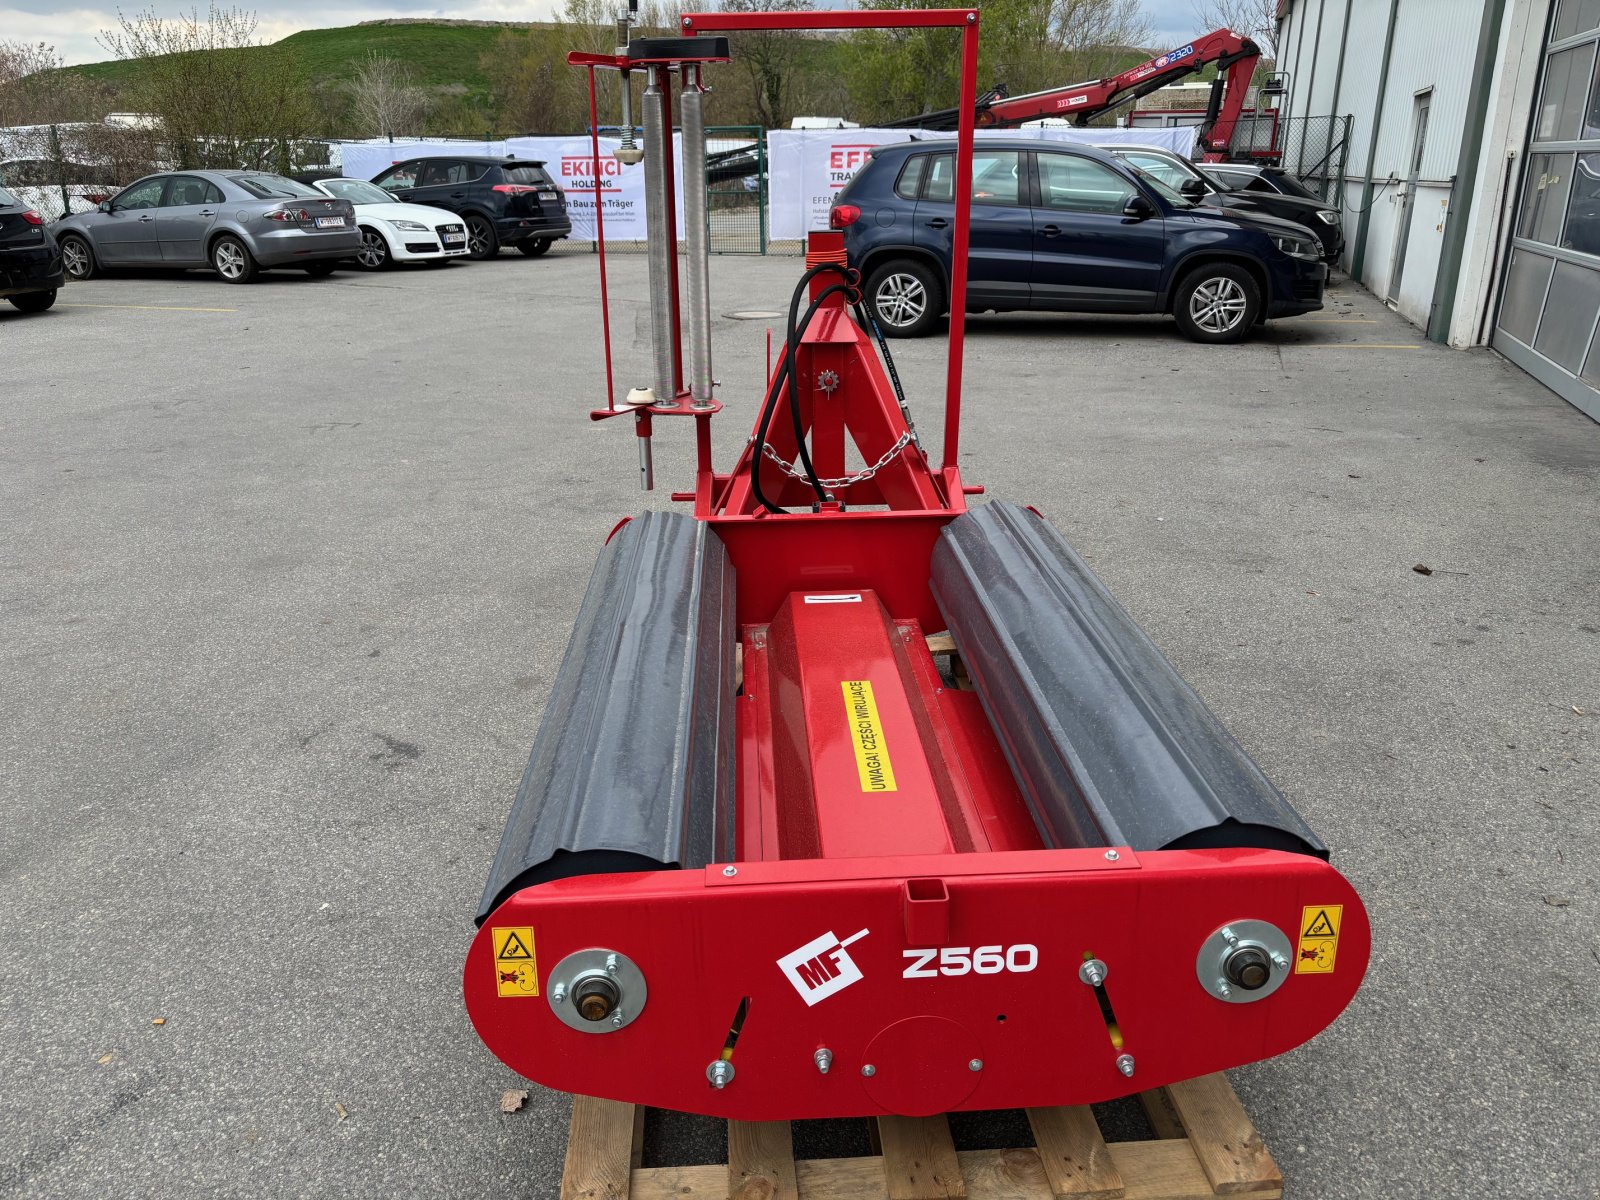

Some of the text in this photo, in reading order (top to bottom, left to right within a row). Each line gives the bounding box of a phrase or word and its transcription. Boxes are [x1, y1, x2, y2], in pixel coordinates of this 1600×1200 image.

[1170, 45, 1194, 62] 2320
[572, 180, 612, 188] HOLDNG
[830, 172, 856, 180] TRA
[573, 200, 588, 208] Bau
[608, 200, 633, 209] Träger
[850, 682, 886, 790] UWAGA! CZĘŚCI WIRUJĄCE
[903, 944, 1038, 978] Z560
[795, 952, 842, 990] MF
